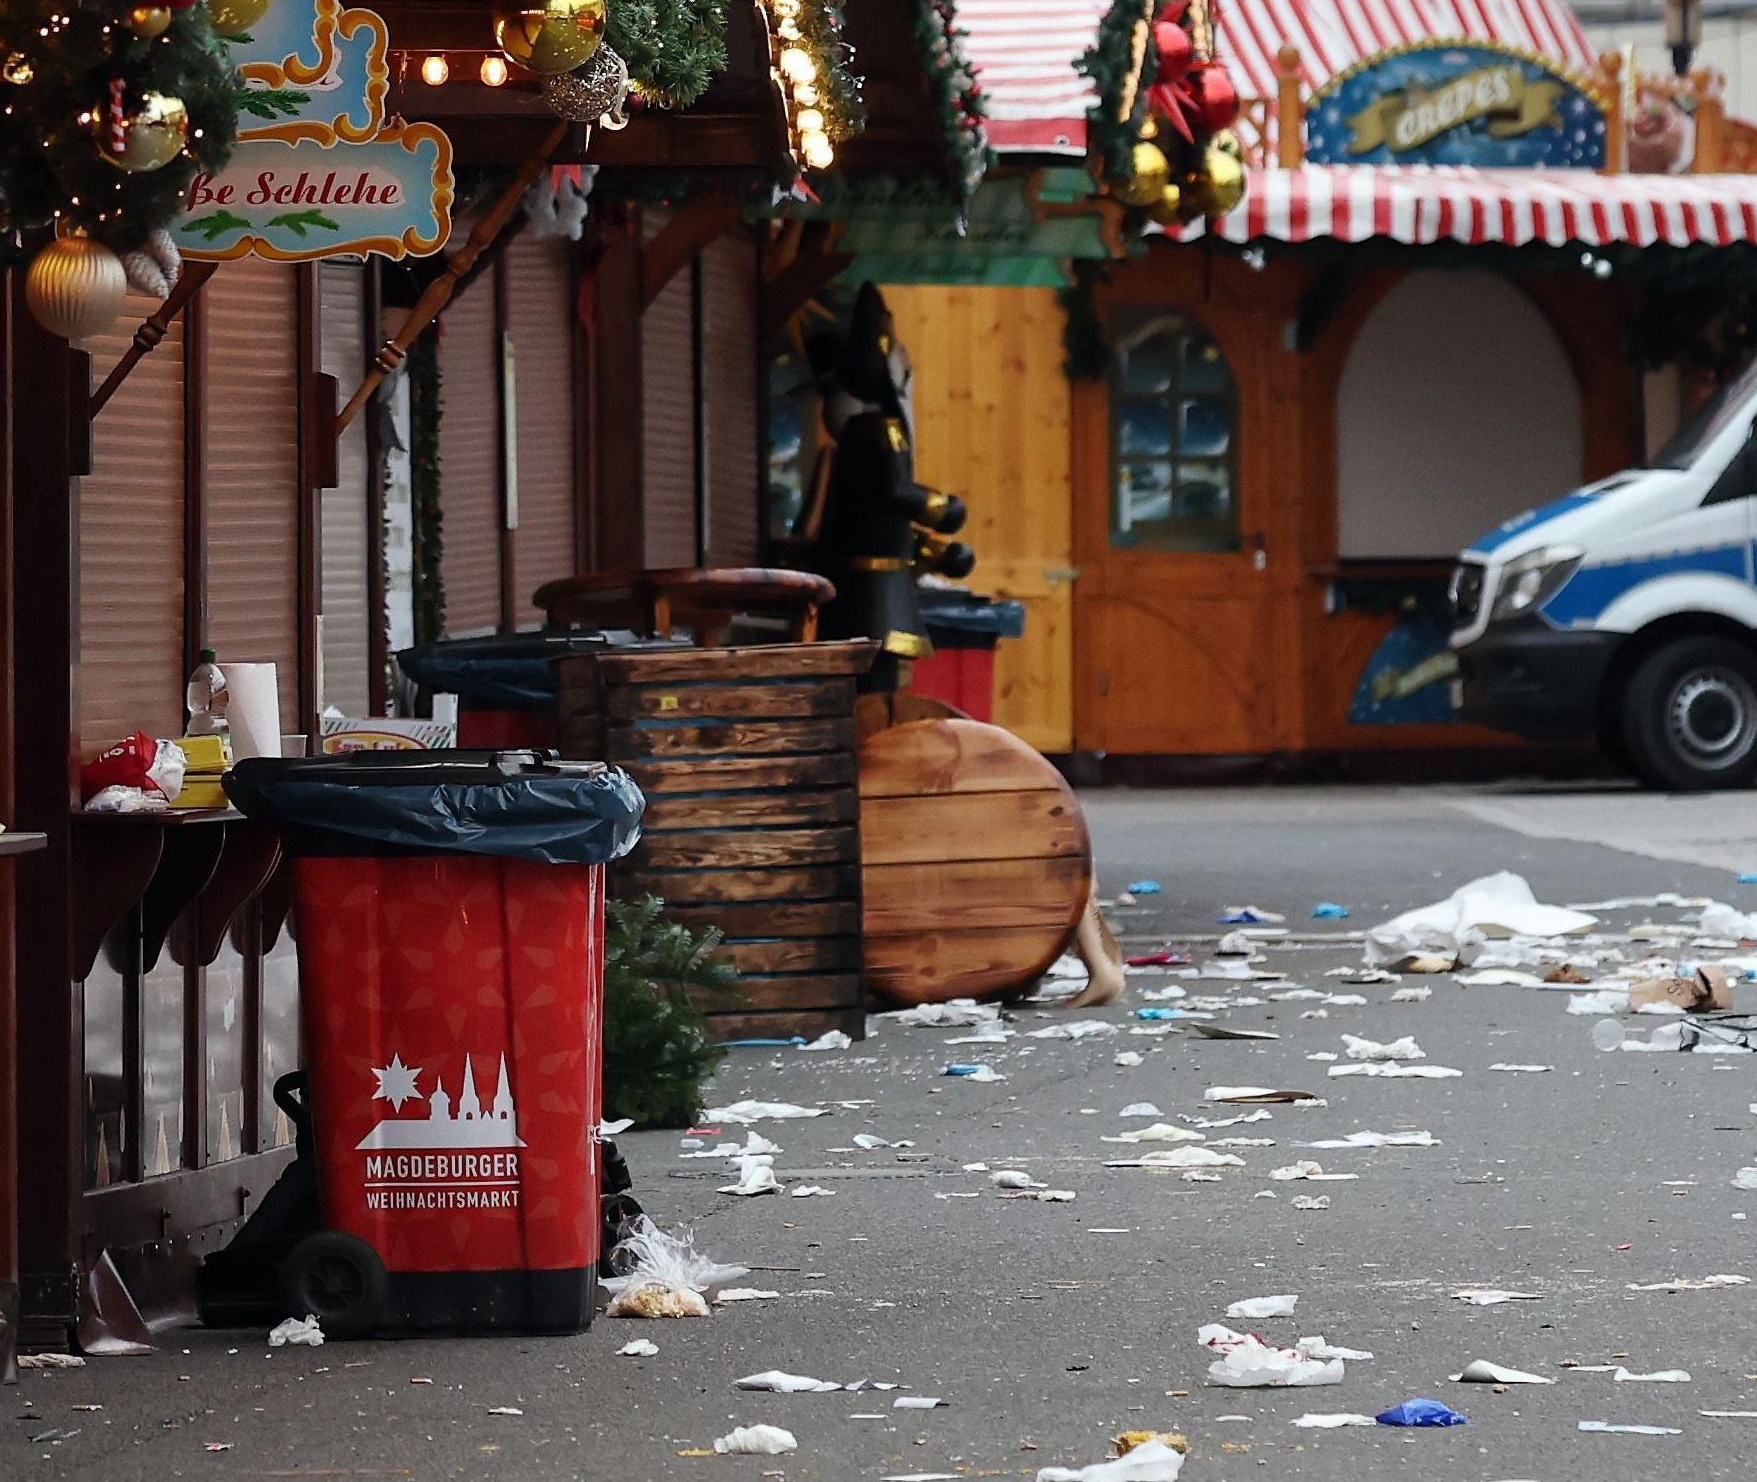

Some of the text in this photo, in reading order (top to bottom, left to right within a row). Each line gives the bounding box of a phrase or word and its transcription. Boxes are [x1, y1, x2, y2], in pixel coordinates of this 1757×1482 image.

[188, 172, 400, 212] ße Schlehe
[366, 1154, 519, 1179] MAGDEBURGER
[366, 1189, 520, 1209] WEIHNACHTSMARKT
